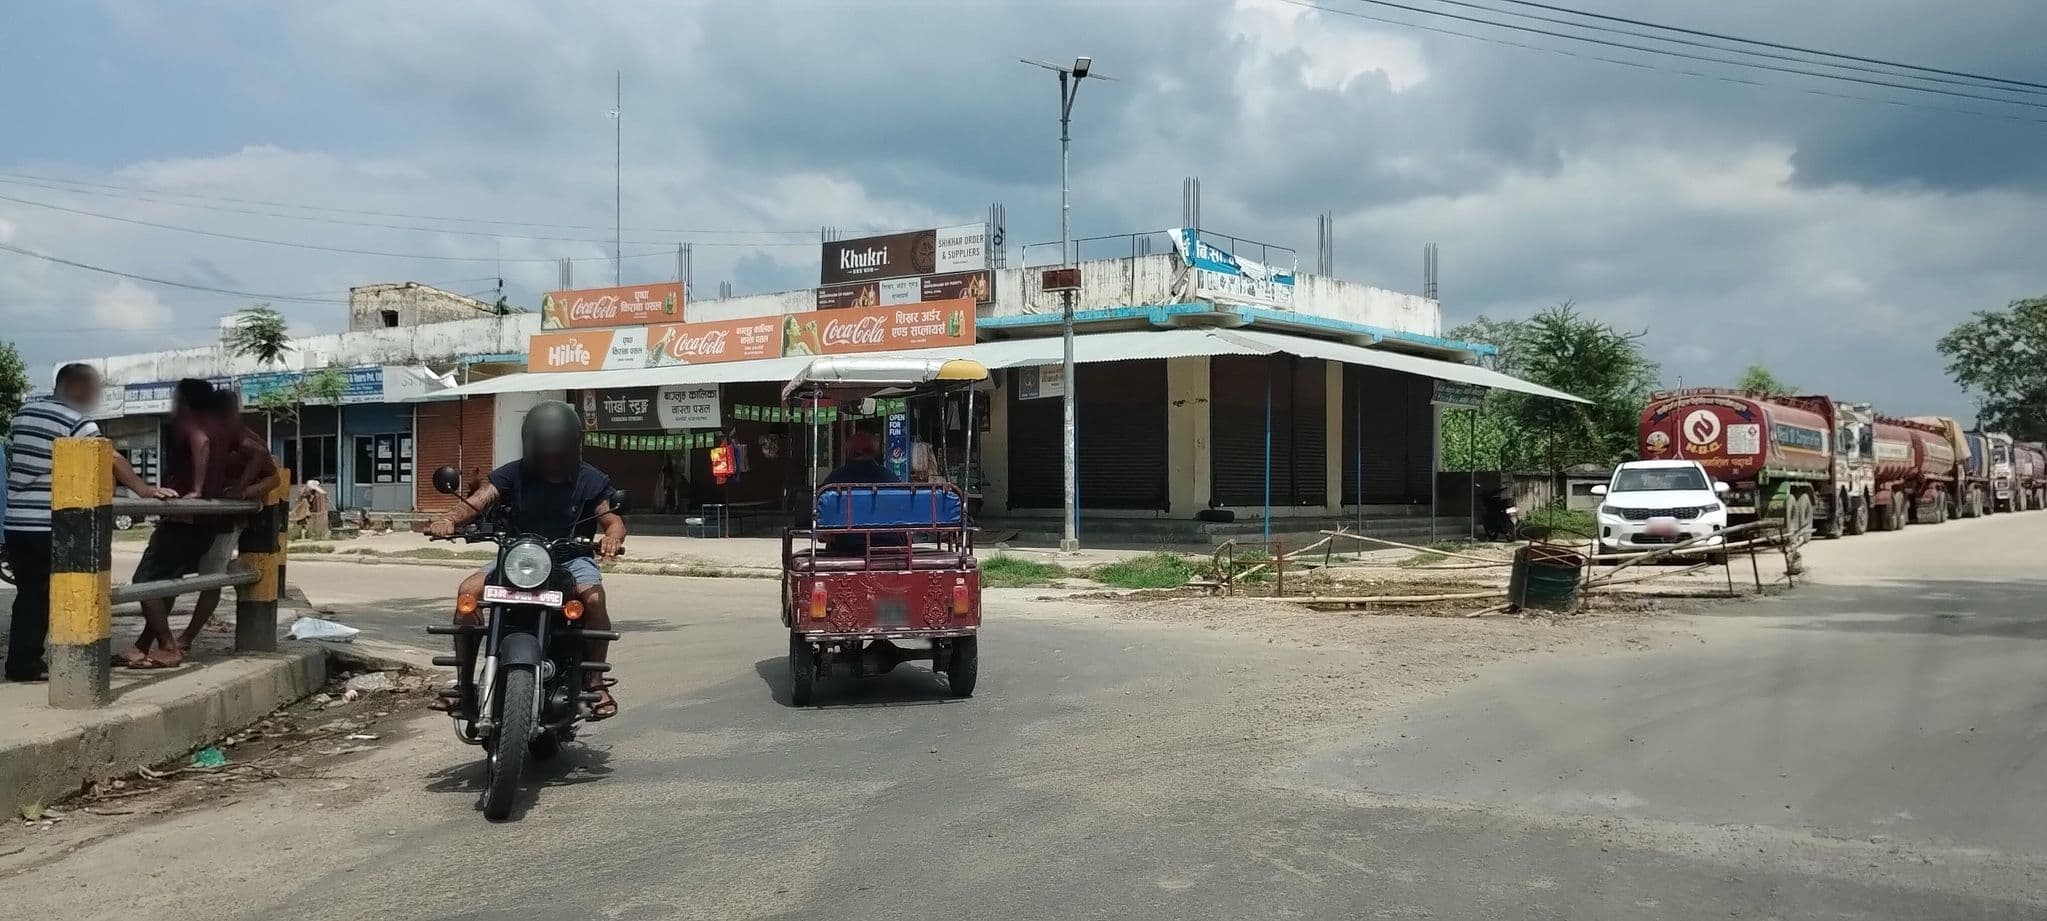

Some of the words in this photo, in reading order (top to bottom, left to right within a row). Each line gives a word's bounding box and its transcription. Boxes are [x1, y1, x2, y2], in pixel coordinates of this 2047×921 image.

[938, 237, 962, 248] SHIKHAR
[964, 234, 984, 245] ORDER
[942, 251, 947, 260] &
[948, 248, 980, 259] SUPPLIERS
[570, 295, 620, 321] Coca-Cola
[895, 310, 919, 324] शिखर
[823, 316, 888, 346] Coca-Cola
[674, 330, 729, 357] Coca-Cola
[889, 421, 901, 429] FOR
